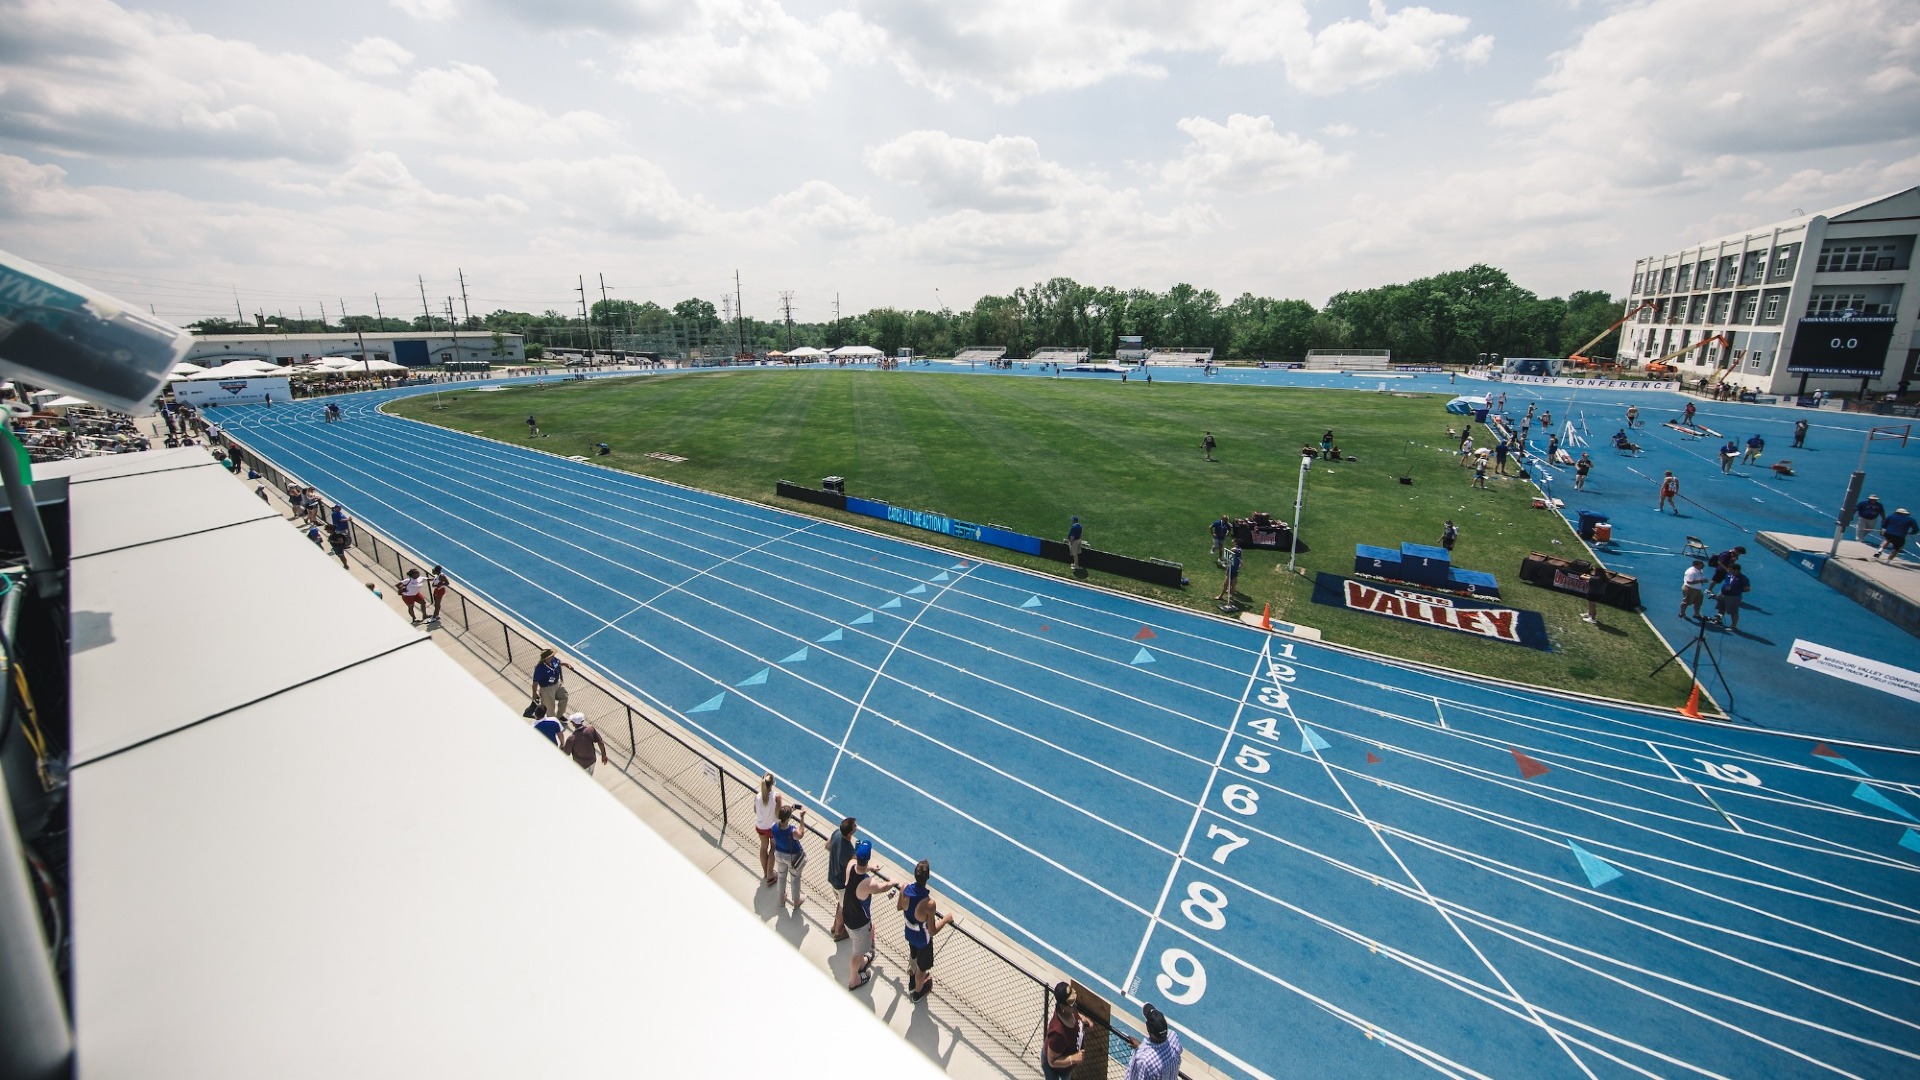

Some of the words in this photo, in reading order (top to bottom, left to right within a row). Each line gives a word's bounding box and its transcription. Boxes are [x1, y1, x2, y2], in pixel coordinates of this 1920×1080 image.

[1830, 338, 1857, 348] 0.0
[1513, 375, 1558, 384] VALLEY
[1566, 378, 1674, 390] CONFERENCE
[887, 506, 904, 522] CATCH
[903, 509, 912, 524] ALL
[912, 511, 922, 527] THE
[922, 513, 941, 532] ACTION
[1373, 559, 1382, 568] 2
[1422, 558, 1428, 567] 1
[1395, 590, 1453, 607] THE
[1467, 584, 1476, 592] 3
[1345, 580, 1519, 641] VALLEY
[1278, 643, 1298, 660] 1
[1267, 663, 1297, 682] 2
[1816, 659, 1843, 671] OUTDOOR
[1845, 667, 1863, 676] TRACK
[1869, 675, 1887, 684] FIELD
[1824, 656, 1856, 669] MISSOURI
[1857, 665, 1884, 676] VALLEY
[1257, 687, 1290, 709] 3
[1248, 717, 1281, 741] 4
[1234, 744, 1271, 774] 5
[1222, 784, 1260, 816] 6
[1206, 824, 1250, 865] 7
[1180, 881, 1228, 931] 8
[1156, 947, 1207, 1006] 9
